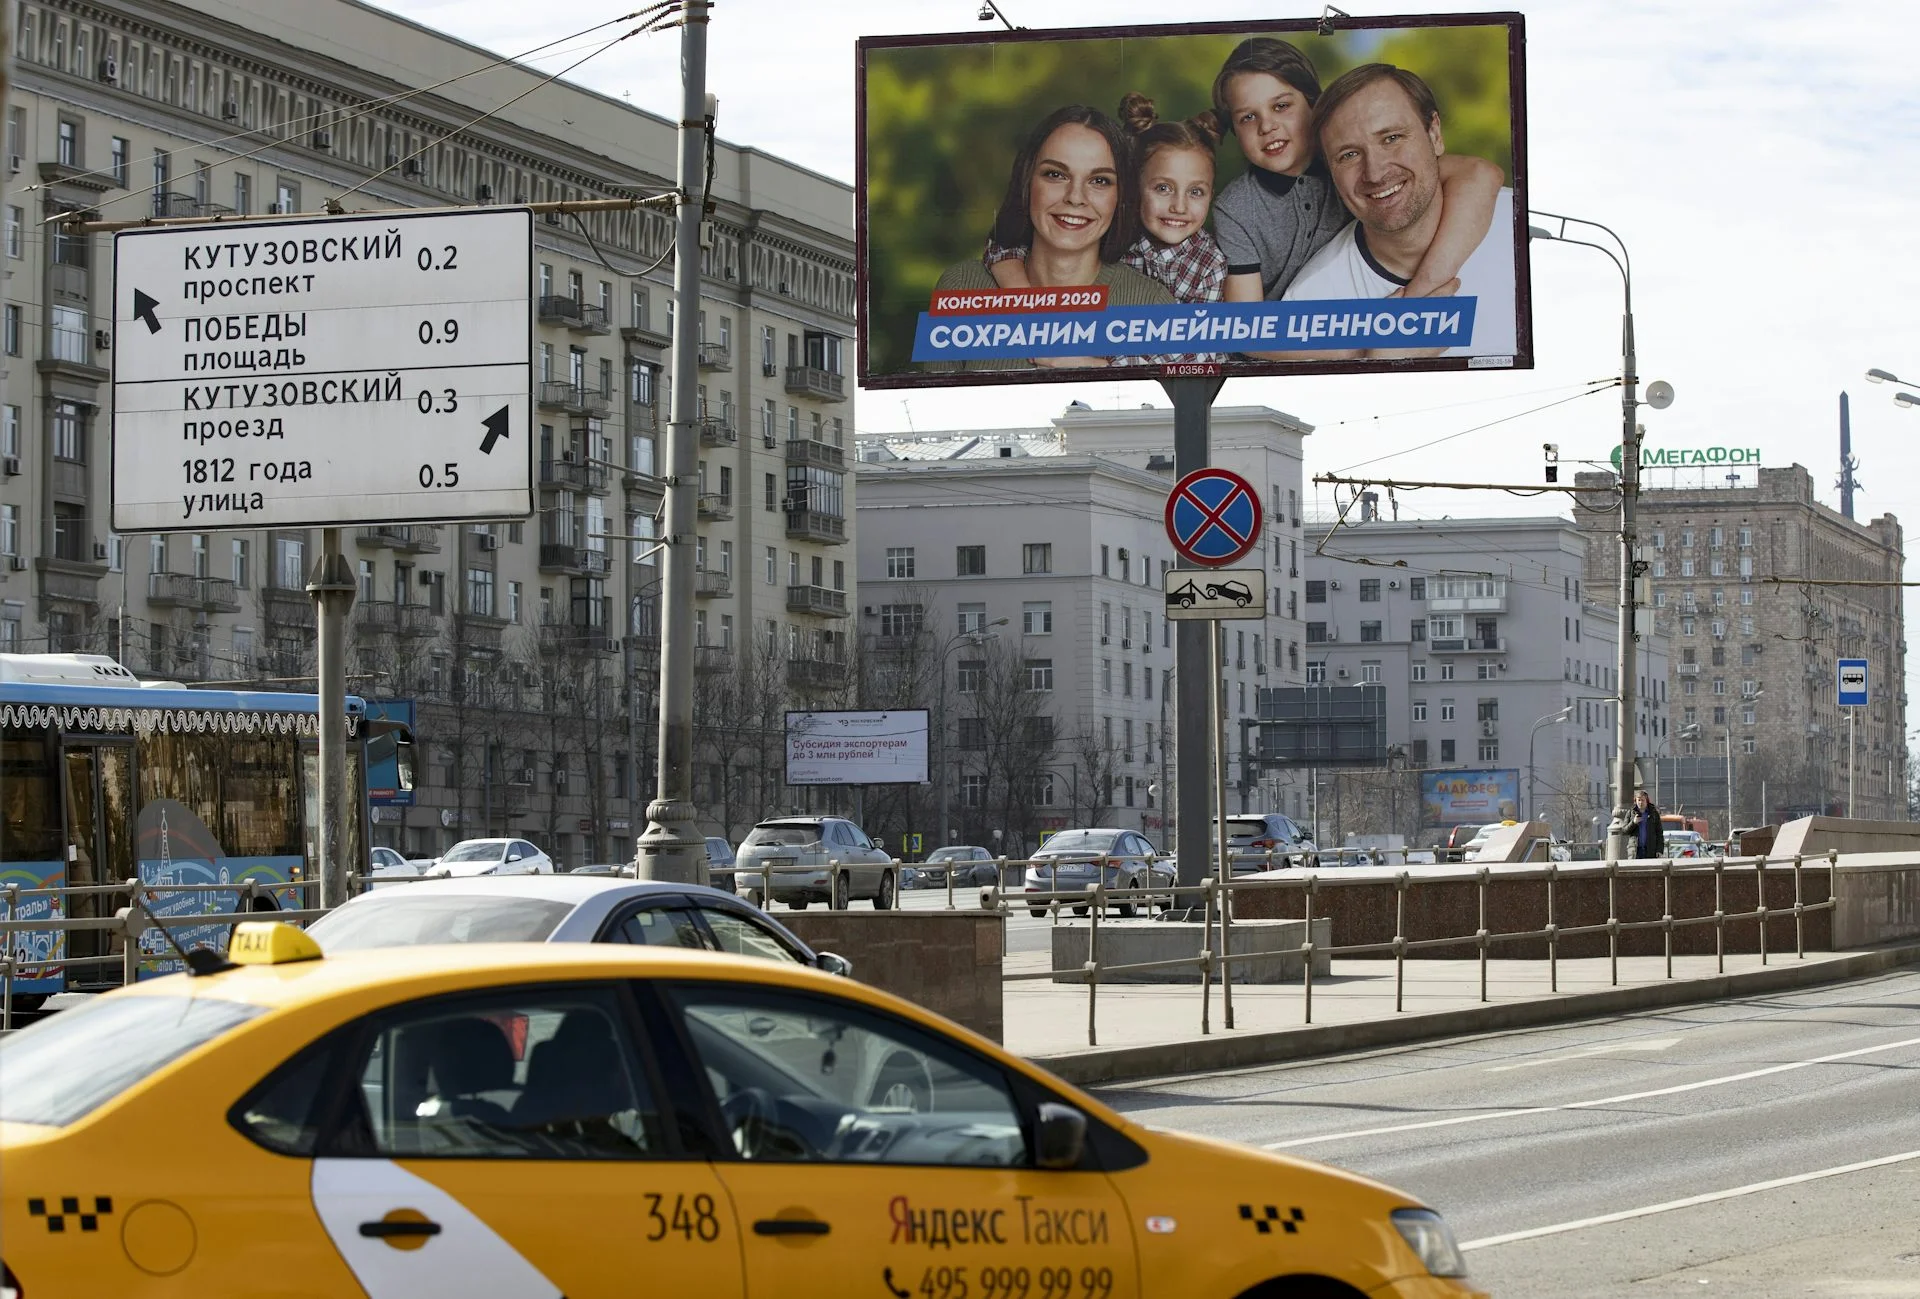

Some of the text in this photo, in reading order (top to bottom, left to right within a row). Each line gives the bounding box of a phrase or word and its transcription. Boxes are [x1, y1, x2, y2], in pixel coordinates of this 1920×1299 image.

[185, 228, 458, 271] КУТУЗОВСКИЙ 0.2
[184, 274, 315, 304] проспект
[937, 291, 1101, 310] КОНСТИТУЦИЯ 2020
[185, 313, 459, 344] ПОБЕДЫ 0.9
[929, 309, 1461, 348] СОХРАНИМ СЕМЕЙНЫЕ ЦЕННОСТИ
[184, 346, 306, 371] площадь
[1179, 365, 1204, 375] 0356
[184, 371, 458, 414] КУТУЗОВСКИЙ 0.3
[184, 417, 284, 445] проезд
[183, 458, 459, 488] 1812 года 0.5
[183, 491, 264, 519] улица
[792, 751, 806, 760] до
[816, 751, 836, 759] млн
[838, 749, 874, 760] рублей
[793, 739, 907, 751] Субсидия экспортерам
[1438, 782, 1501, 795] МАКФЕСТ
[237, 933, 269, 952] TAXI
[643, 1193, 719, 1243] 348
[889, 1195, 1109, 1250] Яндекс Такси
[919, 1266, 1113, 1299] 495 999 99 99
